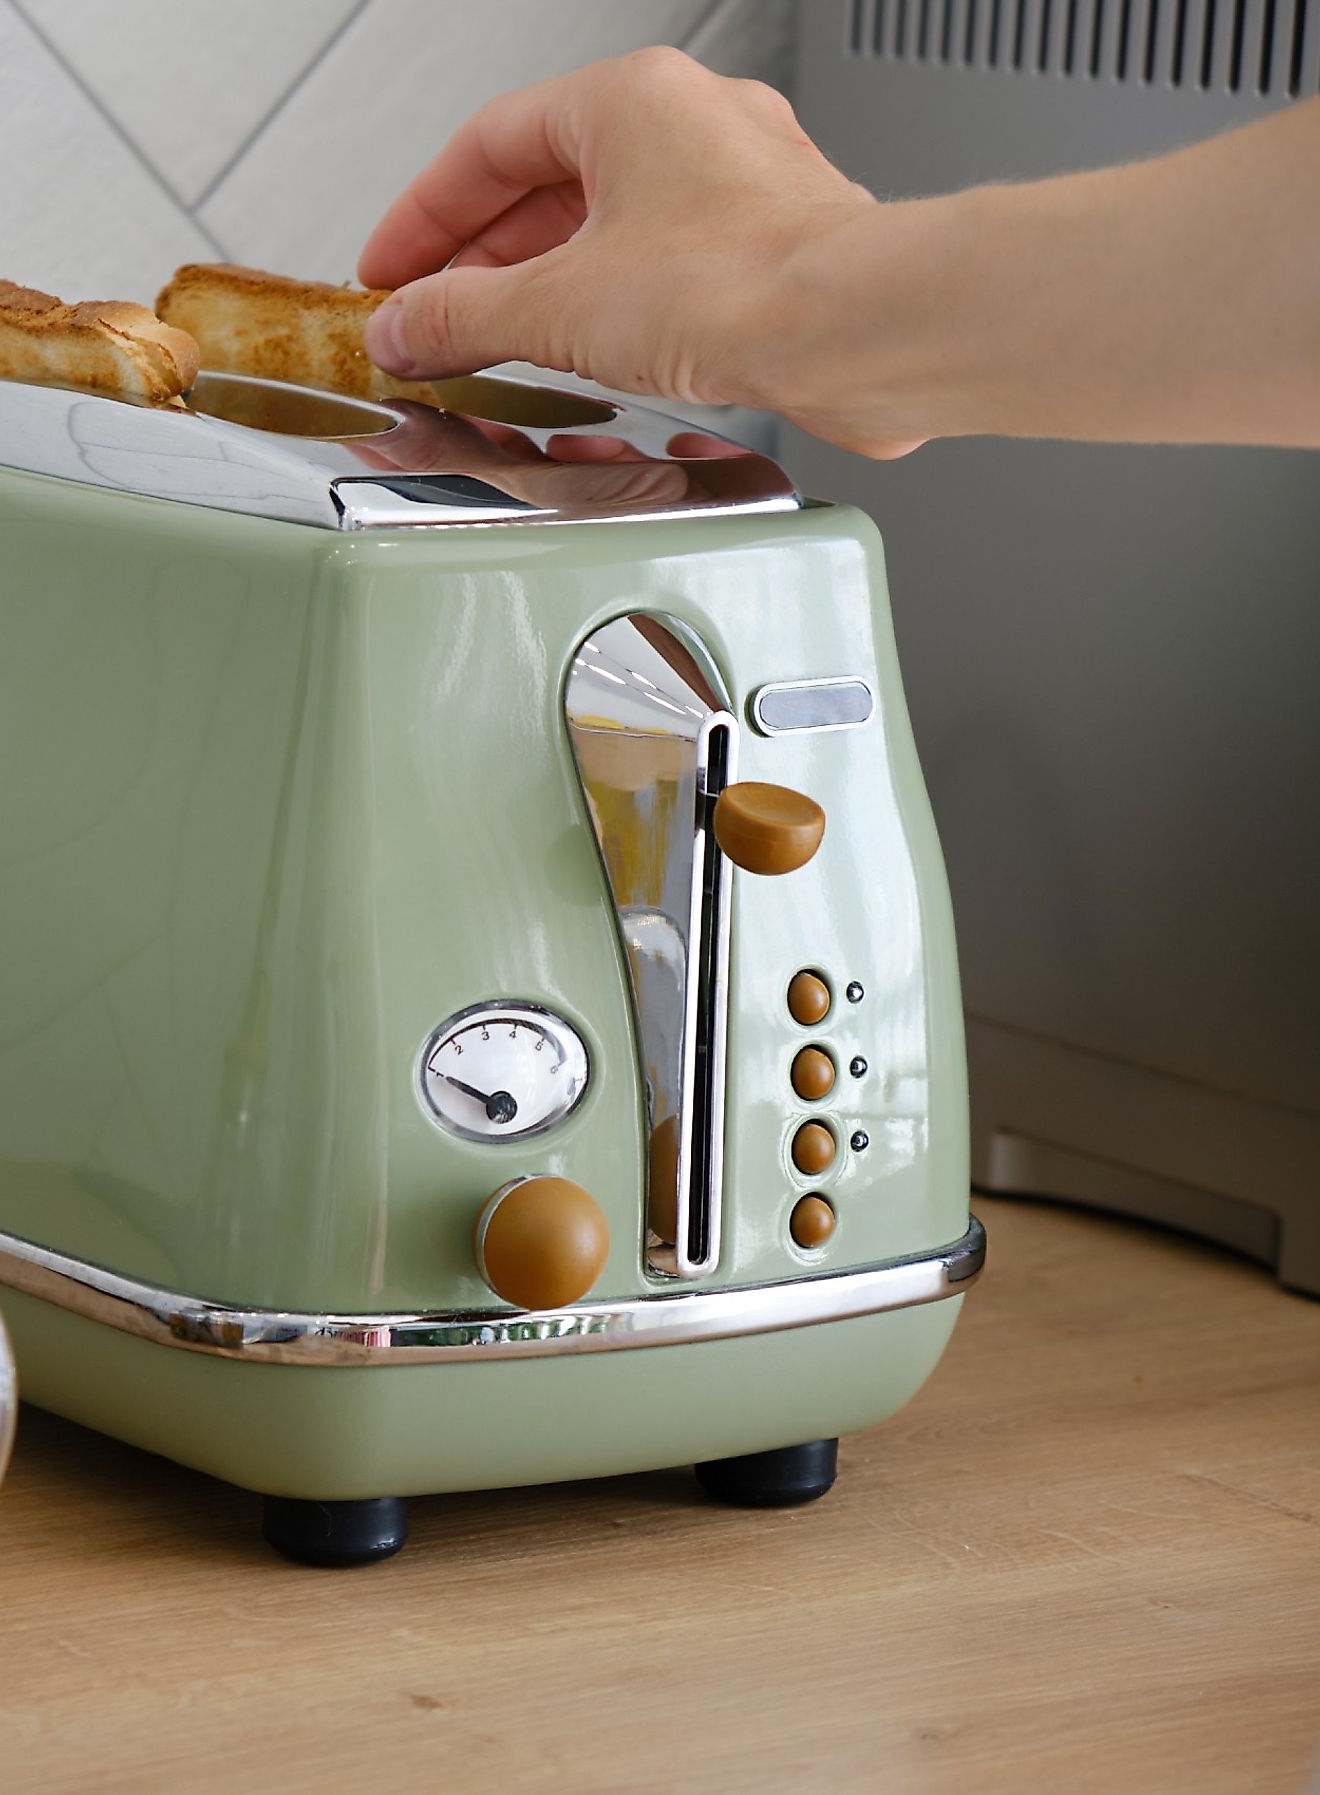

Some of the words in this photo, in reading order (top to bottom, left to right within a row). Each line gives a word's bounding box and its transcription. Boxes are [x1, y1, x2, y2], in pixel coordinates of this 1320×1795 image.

[455, 1045, 463, 1054] 2
[482, 1031, 489, 1040] 3
[509, 1030, 516, 1039] 4
